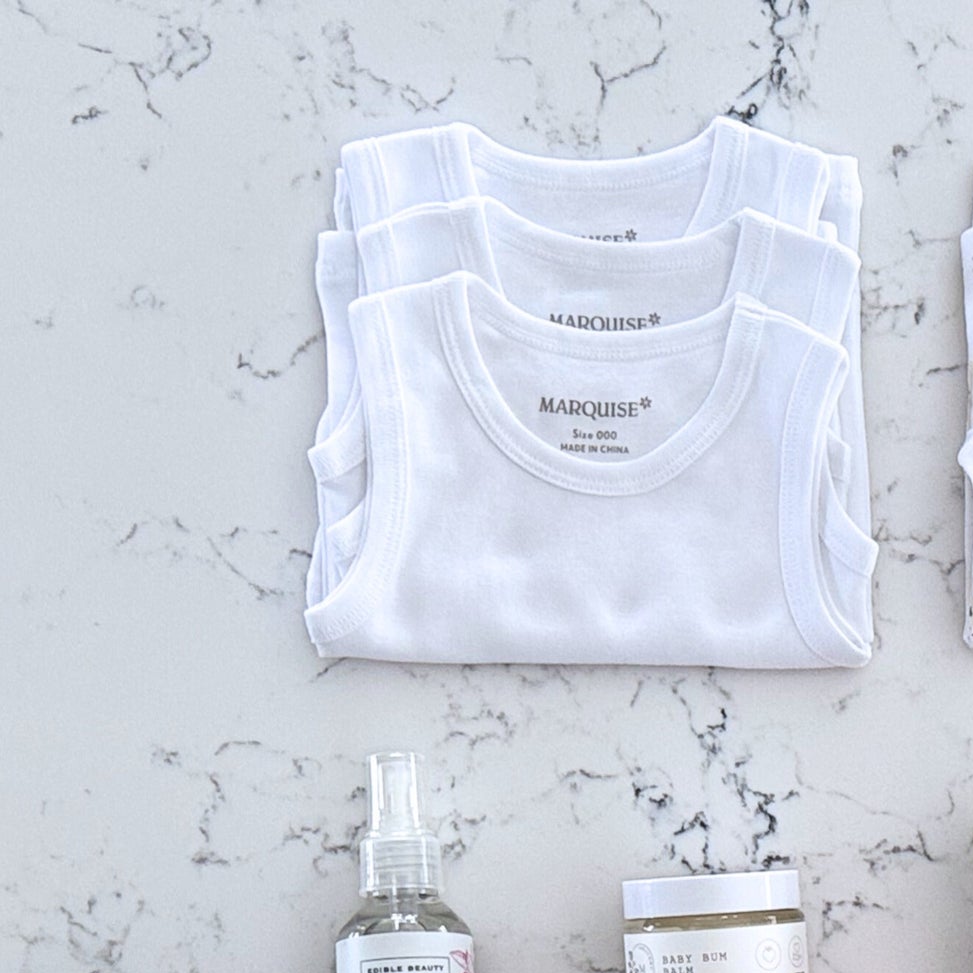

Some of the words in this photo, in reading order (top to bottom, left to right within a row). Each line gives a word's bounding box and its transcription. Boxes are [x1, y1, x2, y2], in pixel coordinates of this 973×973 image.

[539, 397, 640, 420] MARQUISE
[572, 428, 593, 440] Size
[596, 430, 618, 441] 000
[560, 443, 586, 453] MADE
[588, 444, 598, 454] IN
[600, 445, 630, 455] CHINA
[662, 954, 693, 965] BABY
[702, 952, 728, 963] BUM
